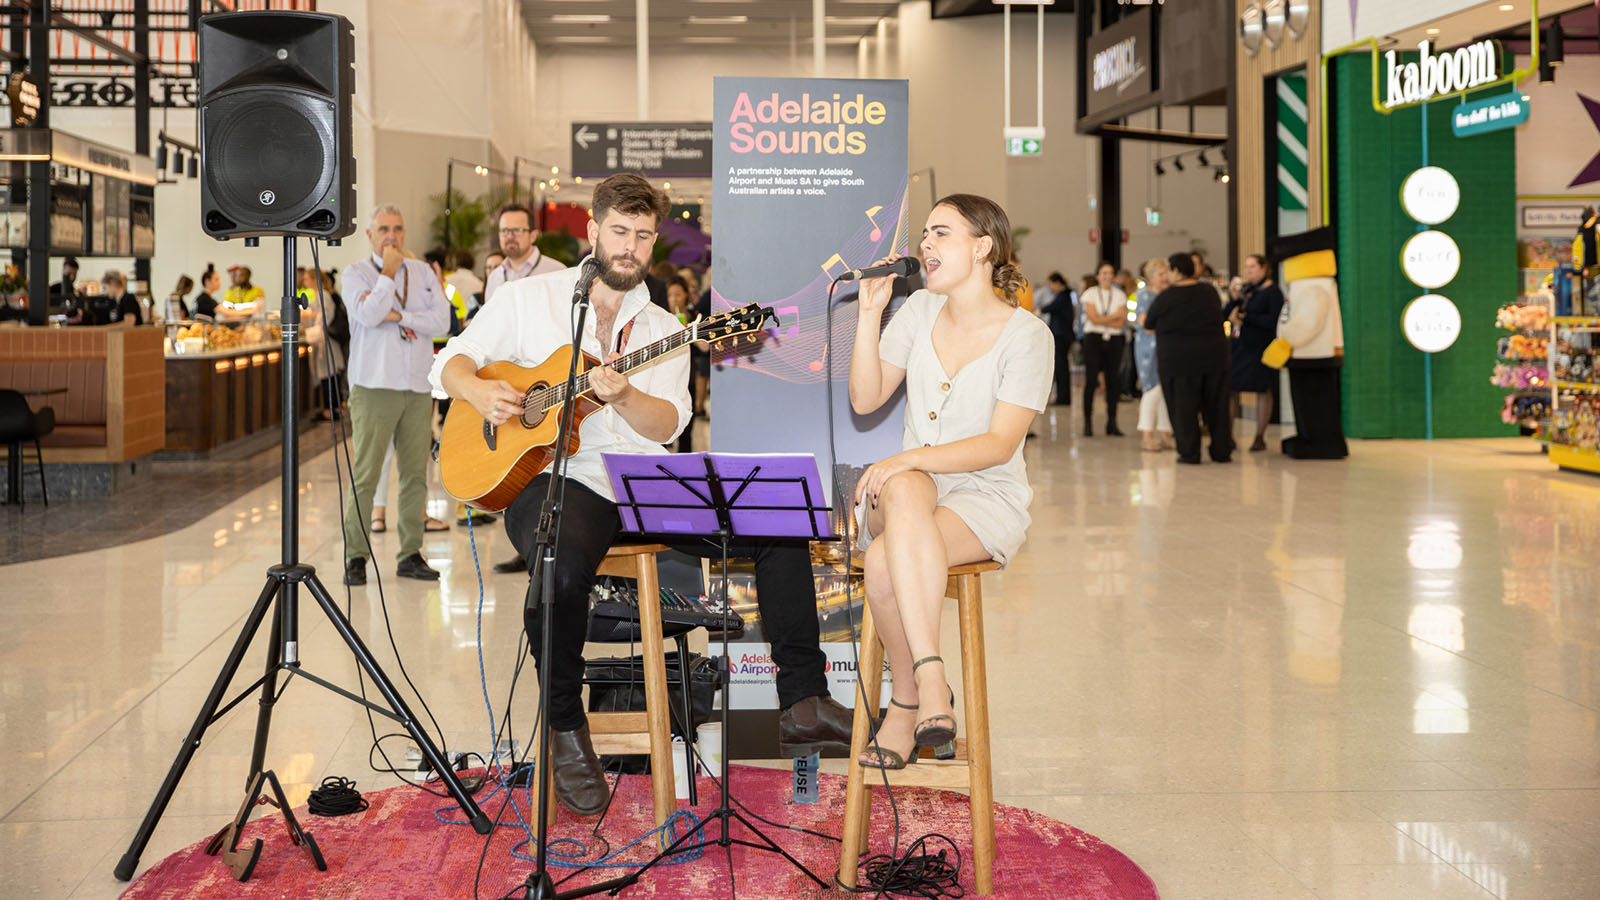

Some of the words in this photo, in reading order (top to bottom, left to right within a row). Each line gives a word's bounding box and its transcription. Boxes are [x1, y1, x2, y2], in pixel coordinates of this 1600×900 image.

[1385, 39, 1498, 108] kaboom
[728, 92, 887, 125] Adelaide
[729, 121, 867, 154] Sounds
[728, 167, 735, 175] A
[737, 167, 782, 177] partnership
[784, 167, 817, 175] between
[819, 168, 853, 176] Adelaide
[728, 177, 756, 186] Airport
[757, 177, 773, 185] and
[774, 177, 798, 185] Music
[800, 177, 811, 185] SA
[813, 177, 821, 185] to
[823, 178, 840, 187] give
[841, 178, 865, 186] South
[728, 187, 768, 195] Australian
[769, 187, 795, 195] artists
[803, 187, 827, 195] voice.
[740, 664, 779, 676] Airport
[797, 755, 808, 794] EUSE
